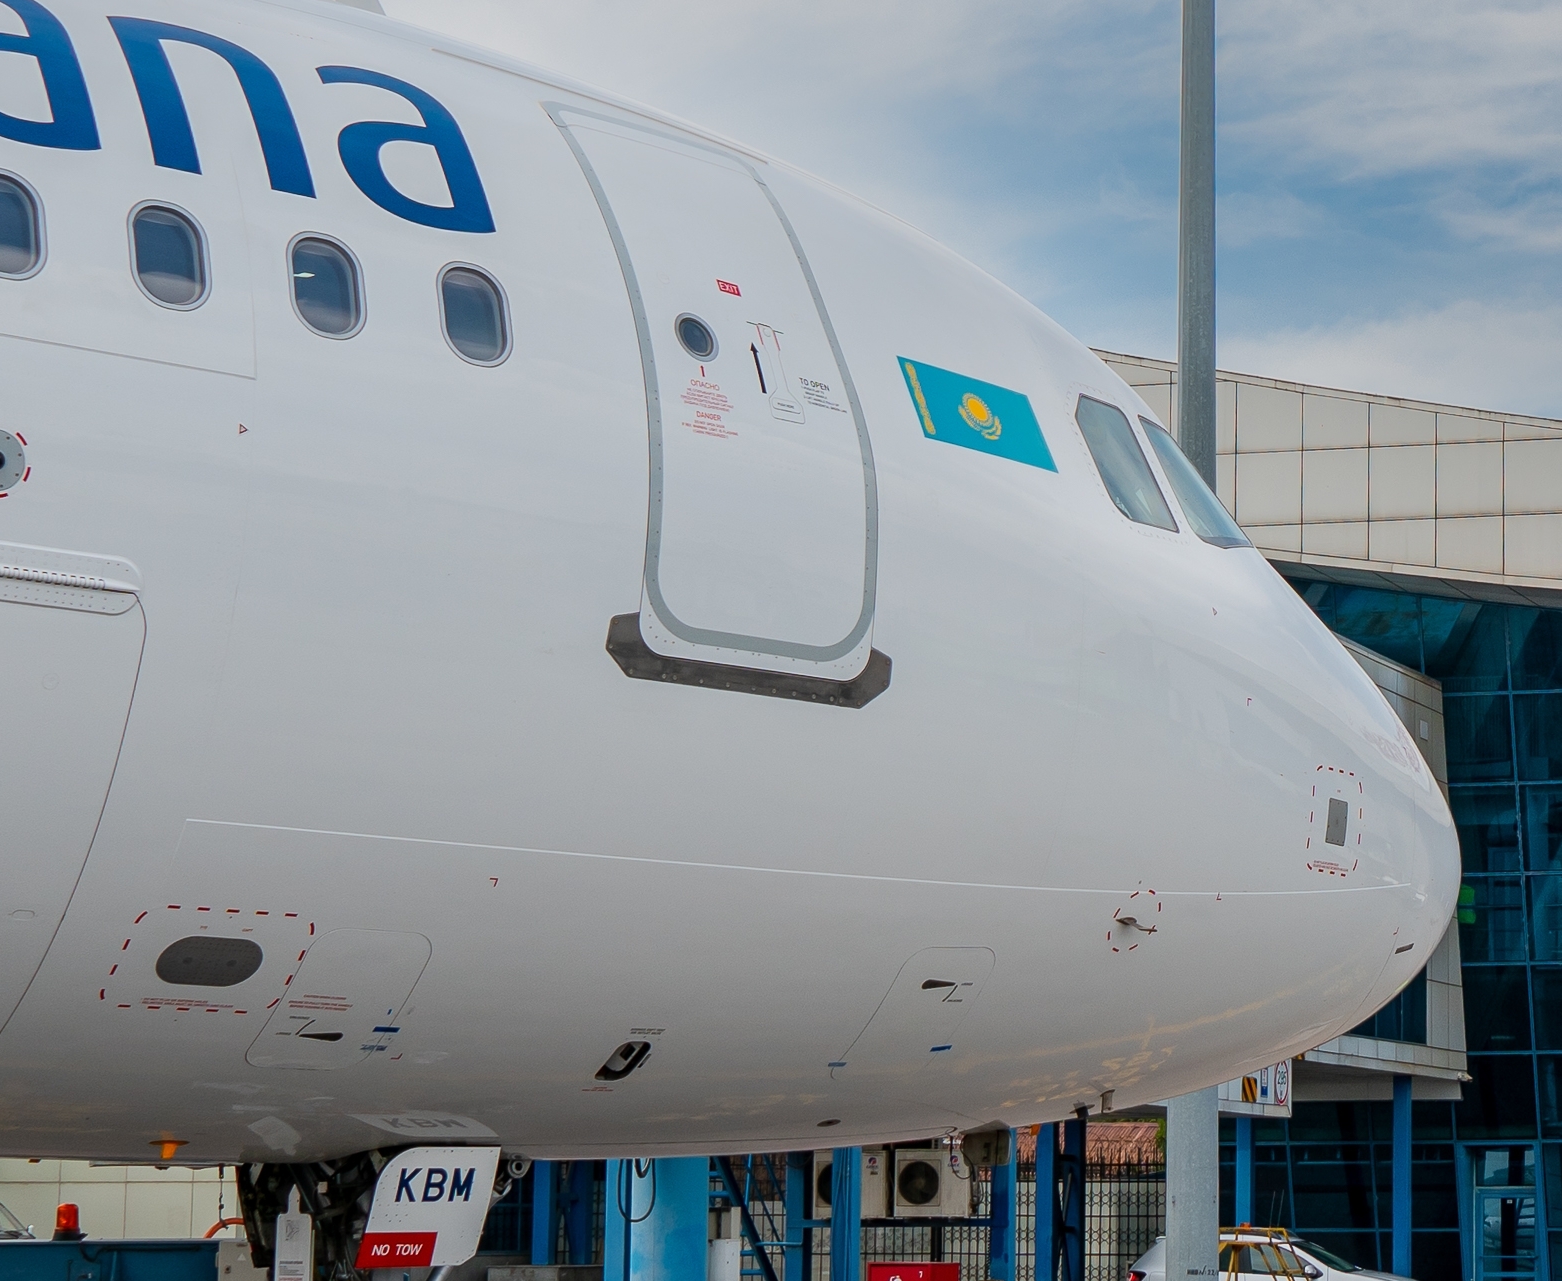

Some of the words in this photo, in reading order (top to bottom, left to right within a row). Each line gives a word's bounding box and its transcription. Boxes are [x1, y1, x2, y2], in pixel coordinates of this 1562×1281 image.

[718, 281, 739, 295] EXIT
[690, 379, 720, 391] ОПАСНО
[798, 376, 809, 386] TO
[810, 380, 830, 392] OPEN
[696, 410, 722, 421] DANGER
[395, 1167, 476, 1203] KBM
[371, 1244, 390, 1256] NO
[395, 1244, 423, 1256] TOW
